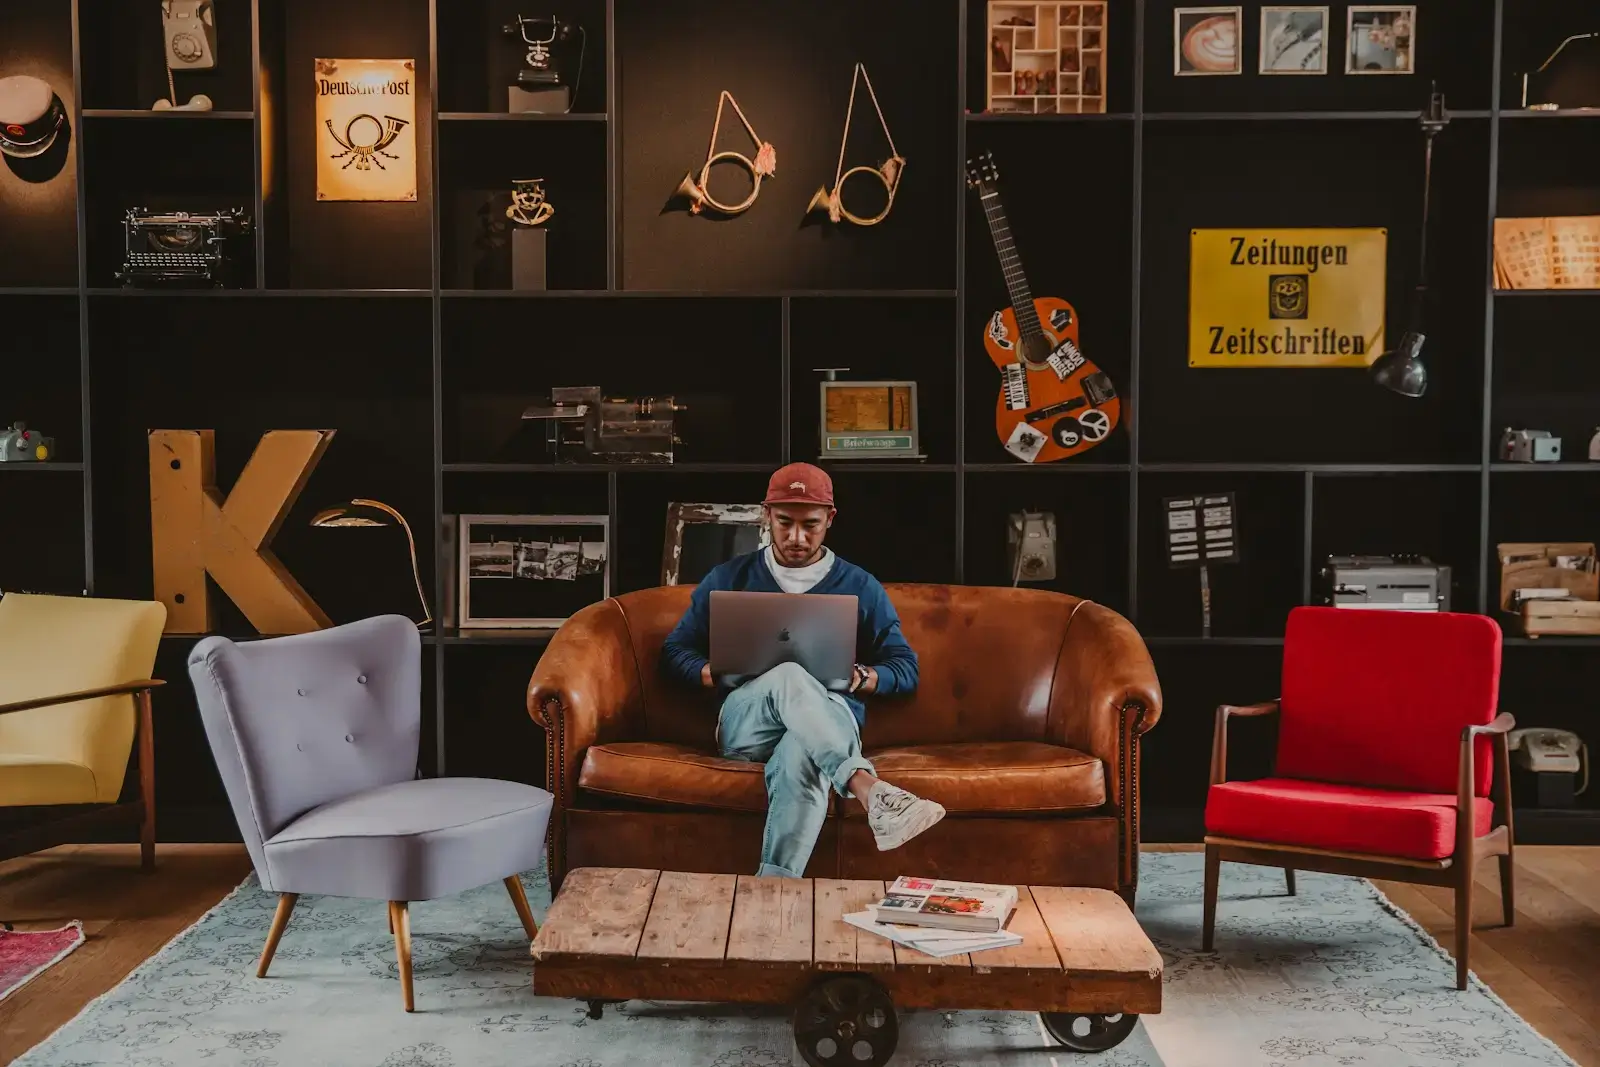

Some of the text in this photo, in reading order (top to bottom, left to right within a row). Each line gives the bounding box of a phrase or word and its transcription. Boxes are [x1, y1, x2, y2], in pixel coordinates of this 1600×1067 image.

[1230, 237, 1348, 273] Zeitungen
[1060, 340, 1086, 368] DOWN
[1209, 326, 1366, 355] Zeitschriften
[1009, 369, 1024, 403] ADVISORY
[843, 438, 896, 449] Briefwaage
[148, 430, 337, 634] K
